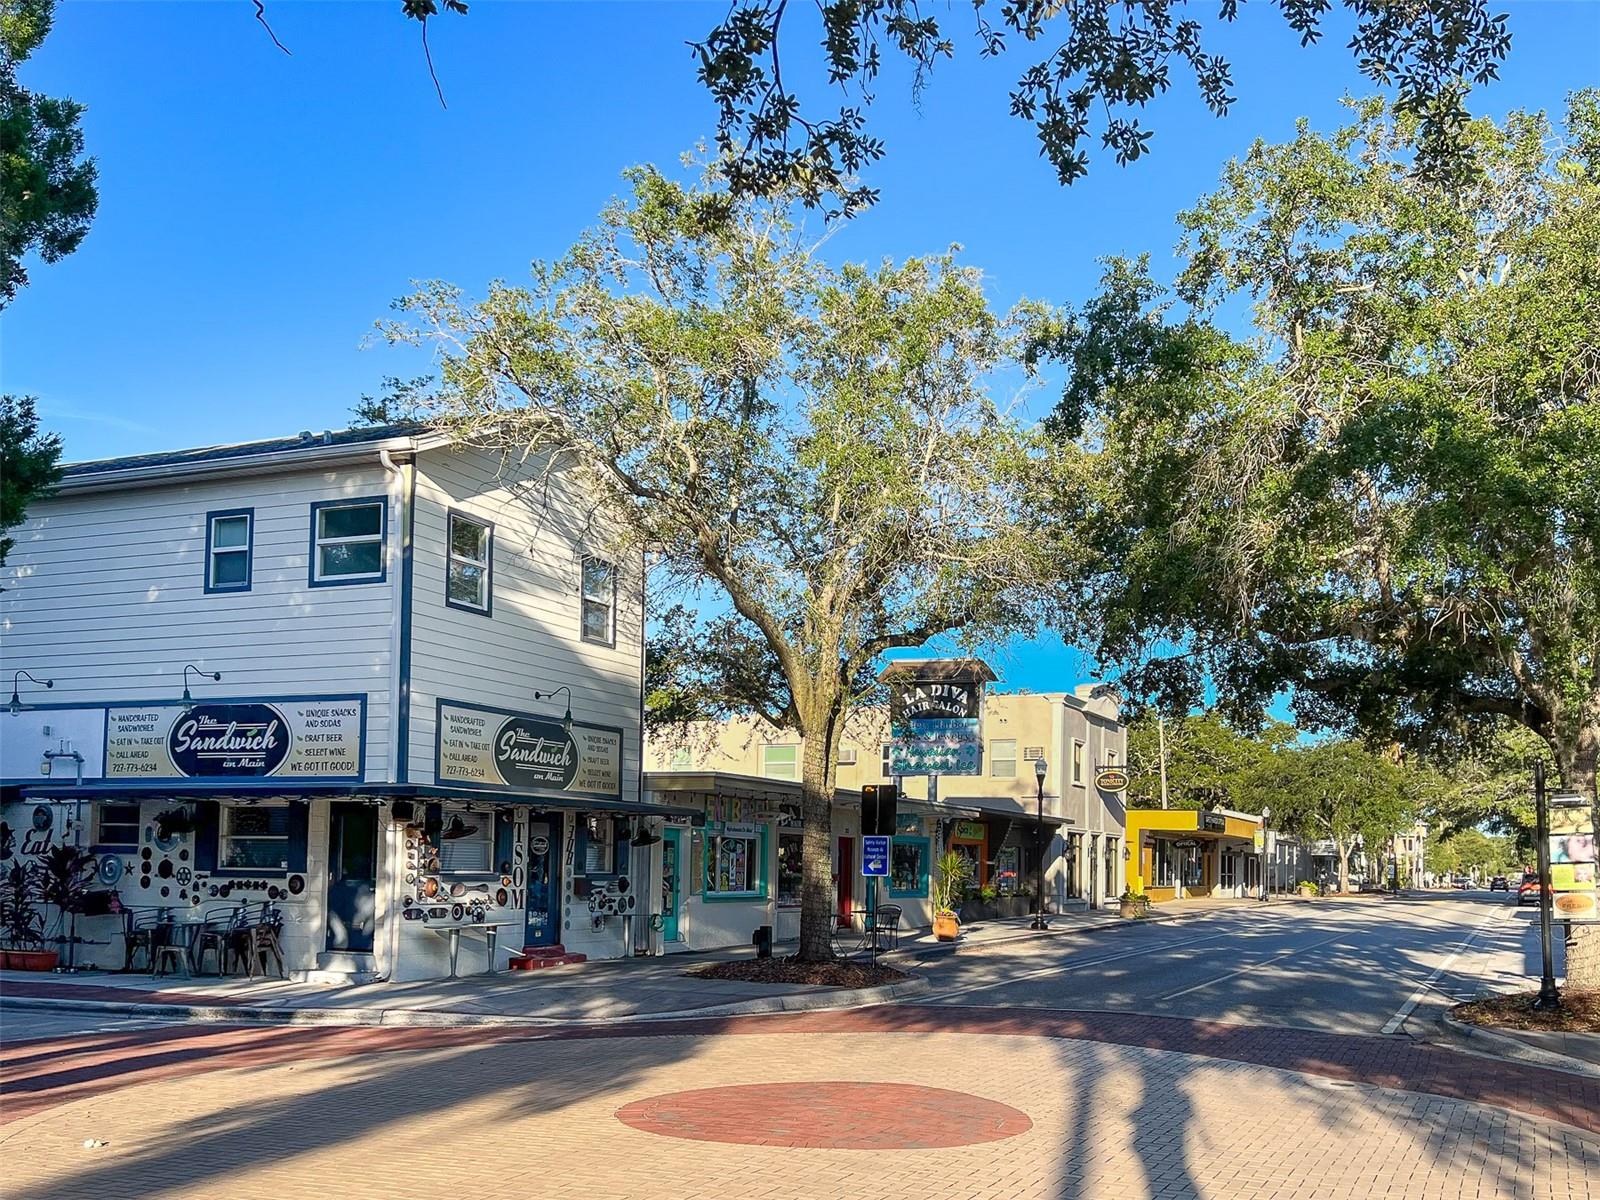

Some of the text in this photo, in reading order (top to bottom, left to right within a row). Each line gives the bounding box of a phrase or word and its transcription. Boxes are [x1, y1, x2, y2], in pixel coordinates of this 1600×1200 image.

[902, 684, 969, 705] LA DIVA
[305, 708, 357, 718] UNIQUE SNACKS
[902, 701, 930, 719] HAIR
[118, 714, 160, 722] HANDCRAFTED
[198, 715, 218, 725] The
[305, 719, 342, 728] AND SODAS
[449, 714, 486, 727] HANDCRAFTED
[117, 724, 155, 733] SANDWICHES
[449, 725, 482, 737] SANDWICHES
[516, 727, 531, 738] The
[116, 737, 133, 746] EAT IN
[140, 737, 154, 746] TAKE
[174, 719, 279, 753] Sandwich
[304, 733, 343, 743] CRAFT BEER
[449, 739, 464, 749] EAT IN
[470, 742, 481, 751] TAKE
[498, 730, 573, 766] Sandwich
[116, 750, 149, 759] CALL AHEAD
[304, 747, 346, 757] SELECT WINE
[448, 752, 478, 763] CALL AHEAD
[112, 763, 158, 773] 727-773-6234
[222, 758, 266, 769] on Main
[290, 761, 356, 772] WE GOT IT GOOD!
[956, 759, 977, 771] Ice
[446, 765, 485, 777] 727-773-6234
[544, 771, 564, 782] Main
[20, 828, 54, 856] Eat
